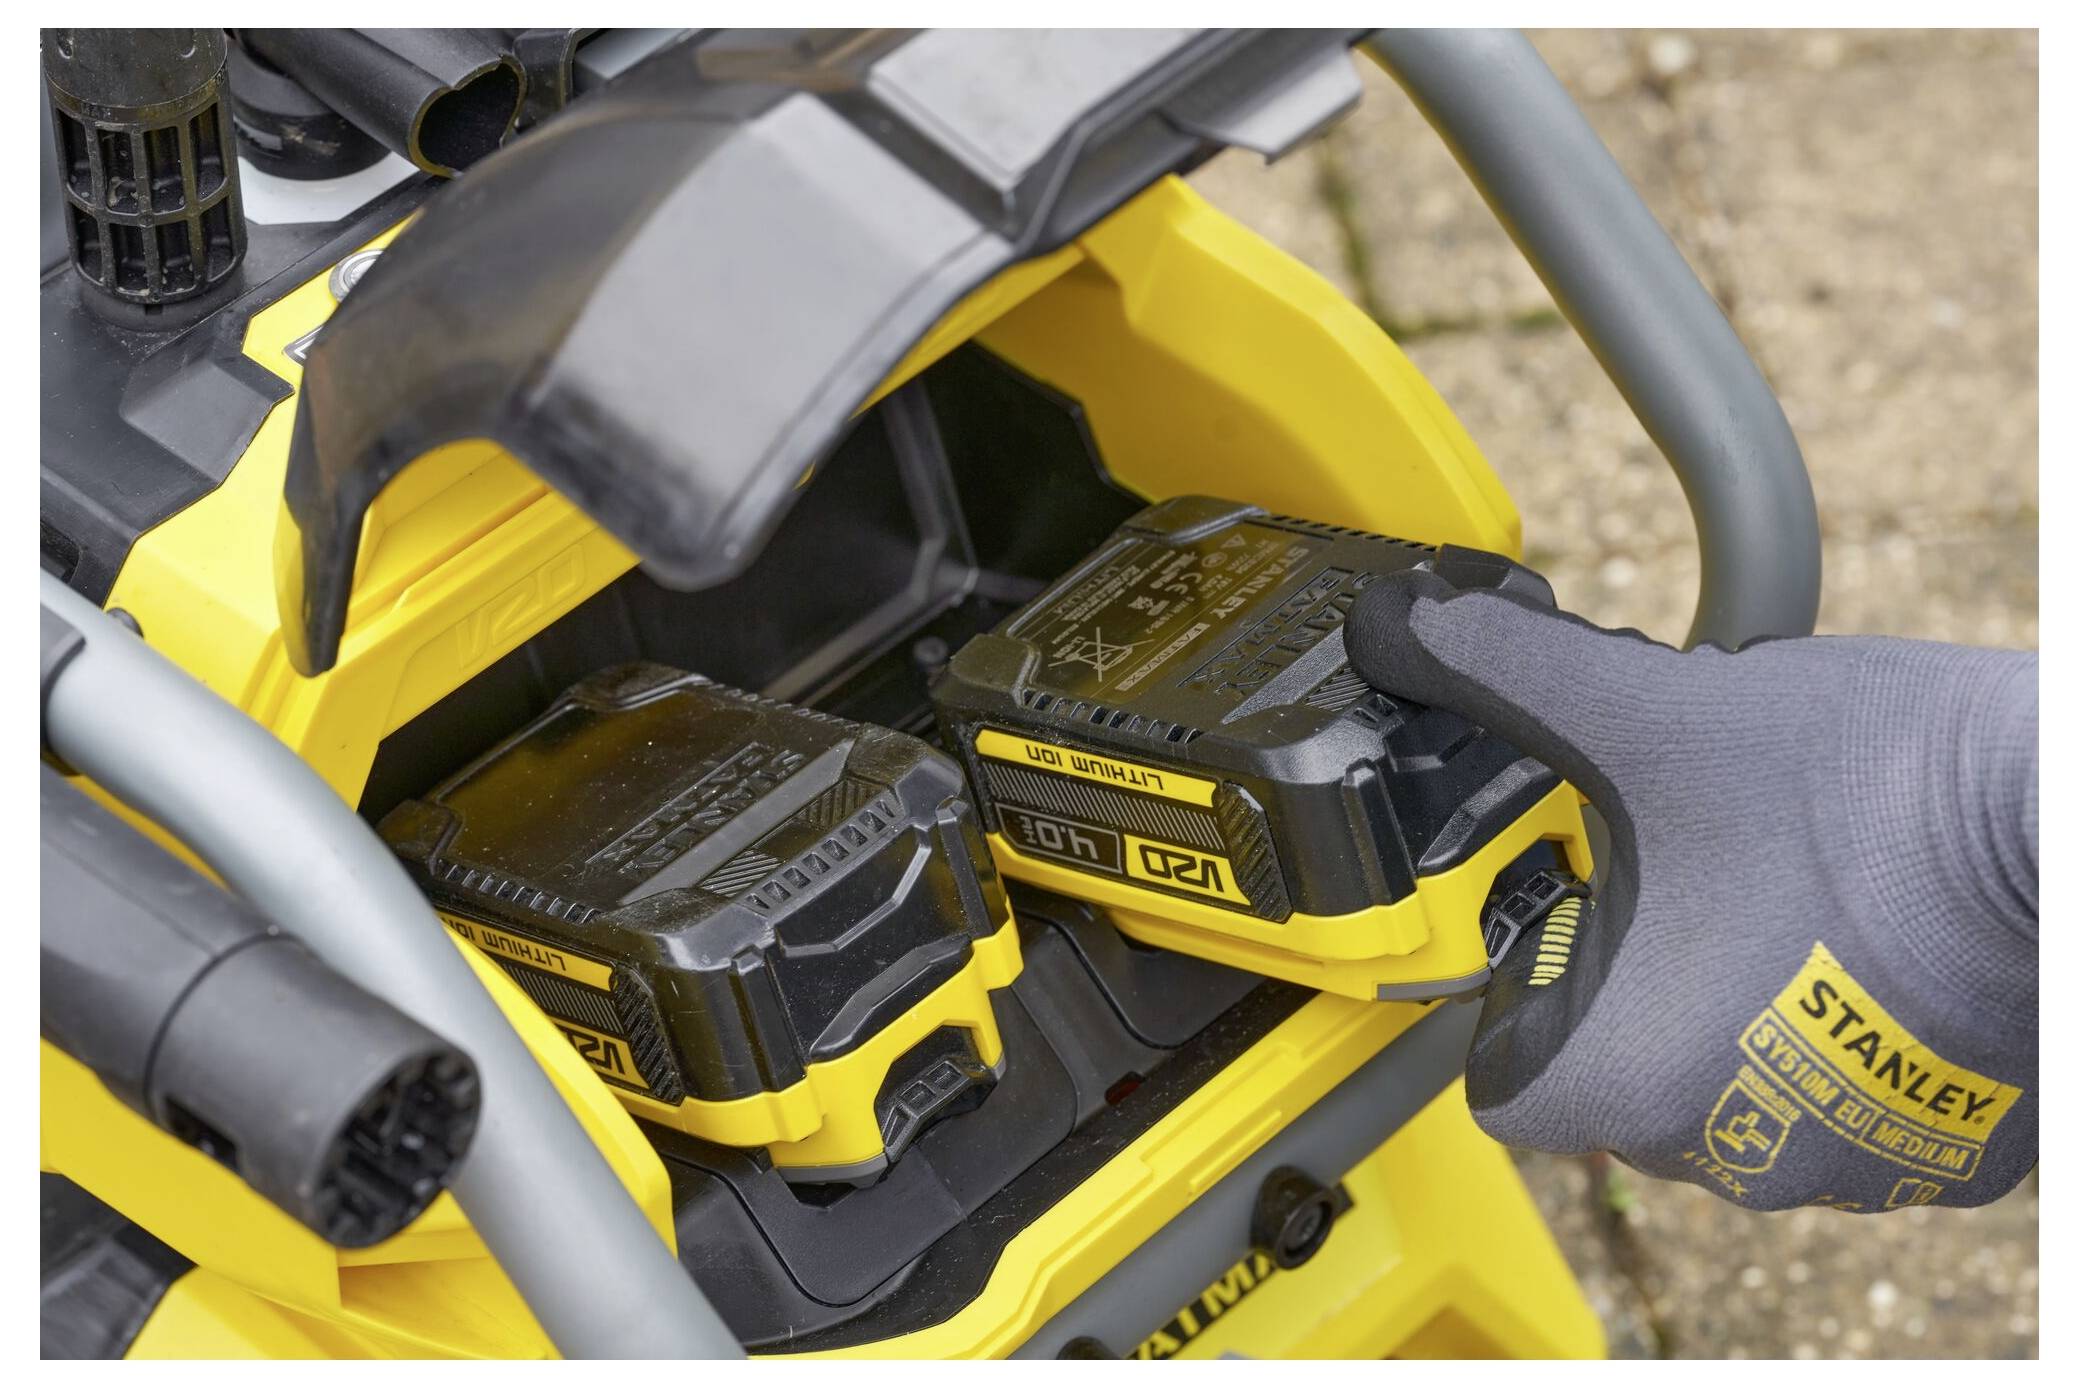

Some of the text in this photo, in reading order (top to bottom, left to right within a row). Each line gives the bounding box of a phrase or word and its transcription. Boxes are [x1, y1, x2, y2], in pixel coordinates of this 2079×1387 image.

[1211, 548, 1309, 619] STANLEY
[1120, 626, 1205, 685] FATMAX
[1071, 756, 1163, 790] LITHIUM
[1037, 821, 1098, 861] 4.0
[1138, 844, 1224, 893] V20
[482, 930, 567, 972] LITHIUM
[1800, 979, 1995, 1121] STANLEY
[1752, 1023, 1867, 1130] SY510M EU
[1872, 1120, 1969, 1170] MEDIUM
